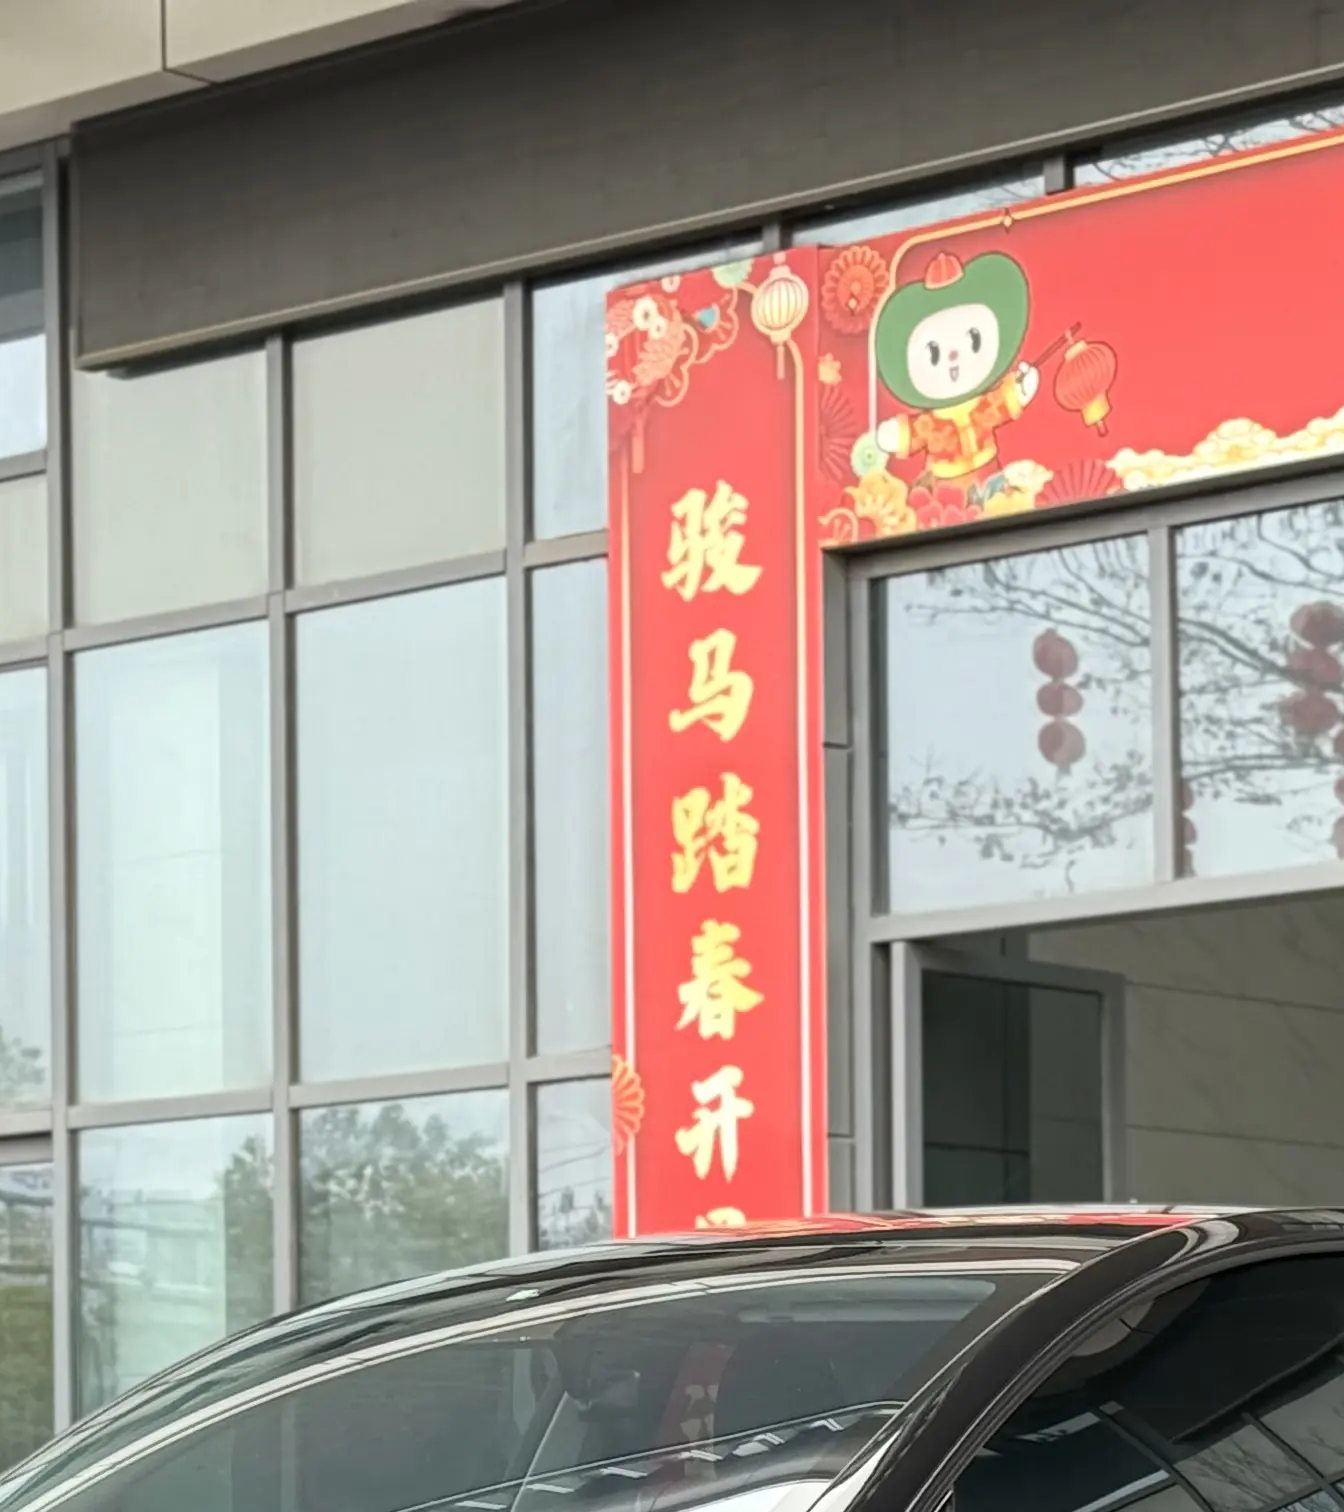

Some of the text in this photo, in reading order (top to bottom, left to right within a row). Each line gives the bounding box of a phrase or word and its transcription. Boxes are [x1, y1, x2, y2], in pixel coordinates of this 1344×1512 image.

[660, 478, 764, 1230] 骏马踏春开
